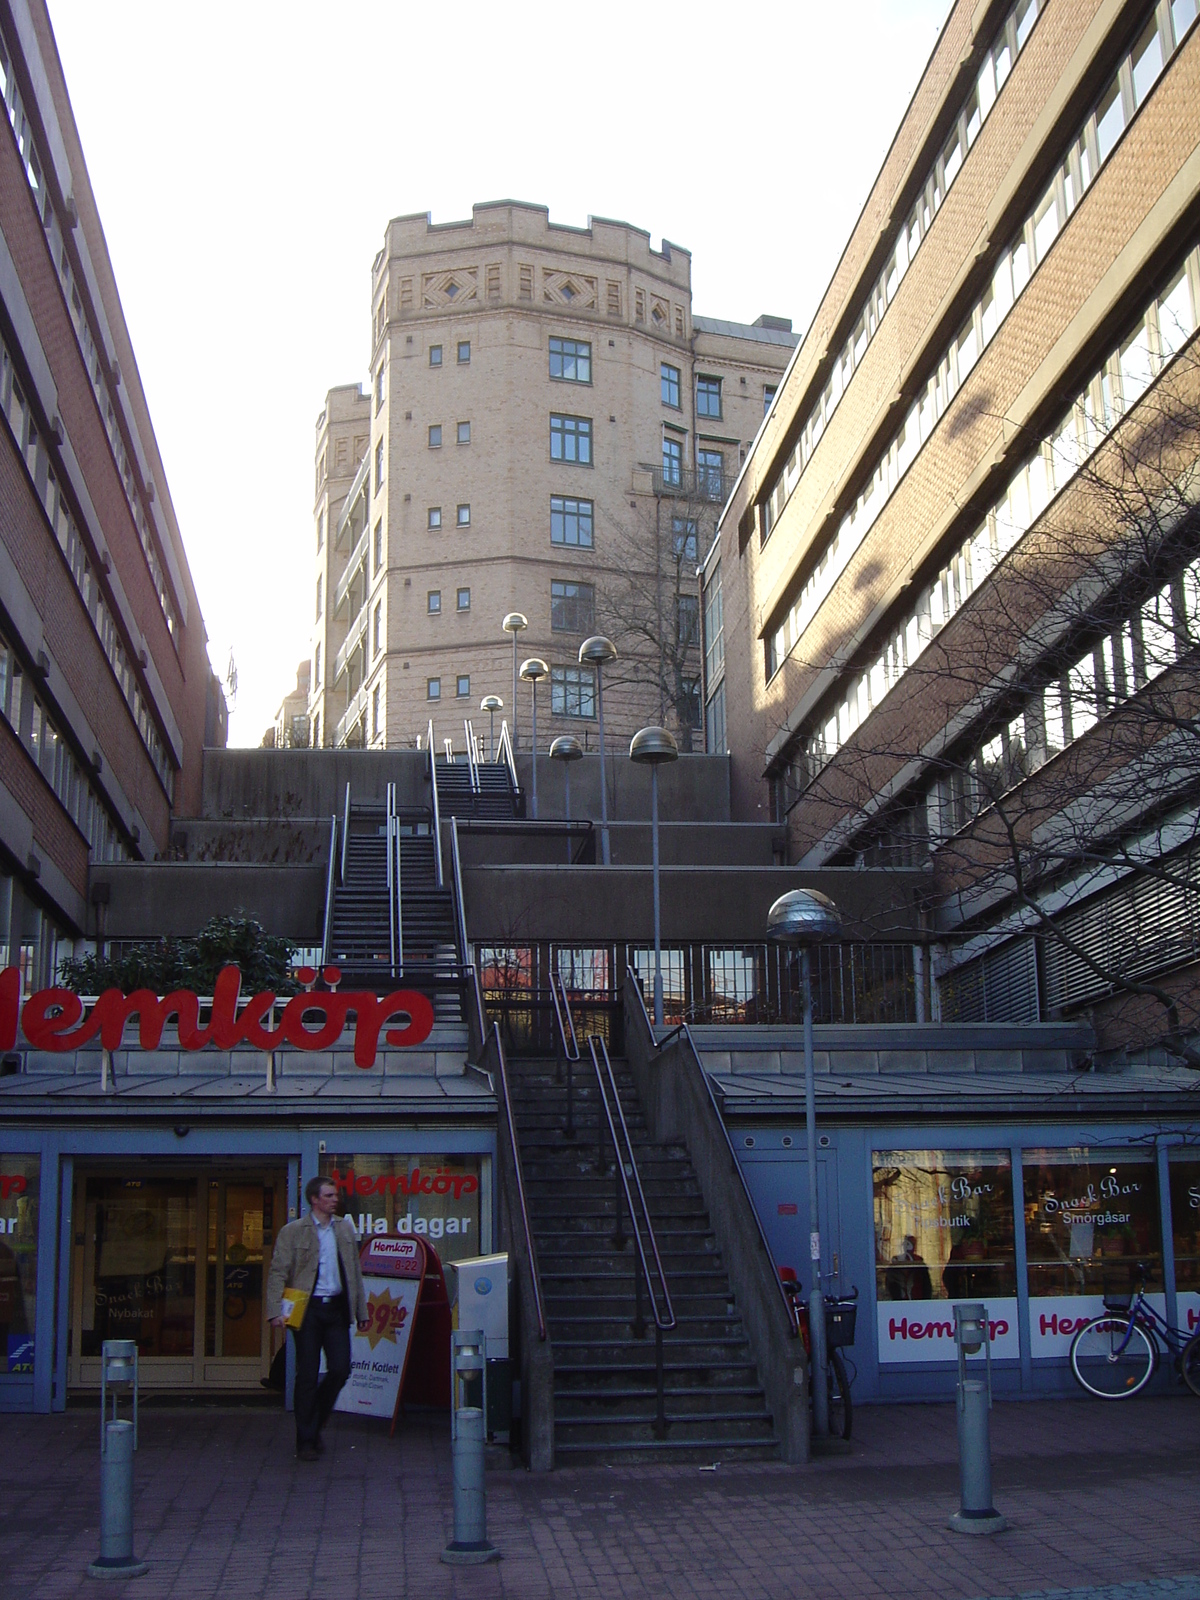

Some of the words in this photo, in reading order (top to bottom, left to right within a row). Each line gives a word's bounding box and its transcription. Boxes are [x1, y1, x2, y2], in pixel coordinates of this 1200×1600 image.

[0, 965, 434, 1069] emköp
[332, 1167, 478, 1200] Hemköp
[951, 1176, 994, 1200] Bar
[1044, 1184, 1100, 1213] Snack
[1101, 1175, 1142, 1199] Bar
[343, 1213, 388, 1234] Alla
[397, 1213, 472, 1239] dagar
[914, 1214, 971, 1229] Tipsbutik
[1062, 1210, 1131, 1226] Smörgåsar
[374, 1241, 414, 1255] Hemköp
[395, 1259, 418, 1271] 8-22
[109, 1308, 154, 1320] Nybakat
[889, 1317, 1009, 1341] Hemp
[350, 1360, 371, 1371] enfri
[372, 1361, 399, 1374] Kotlett
